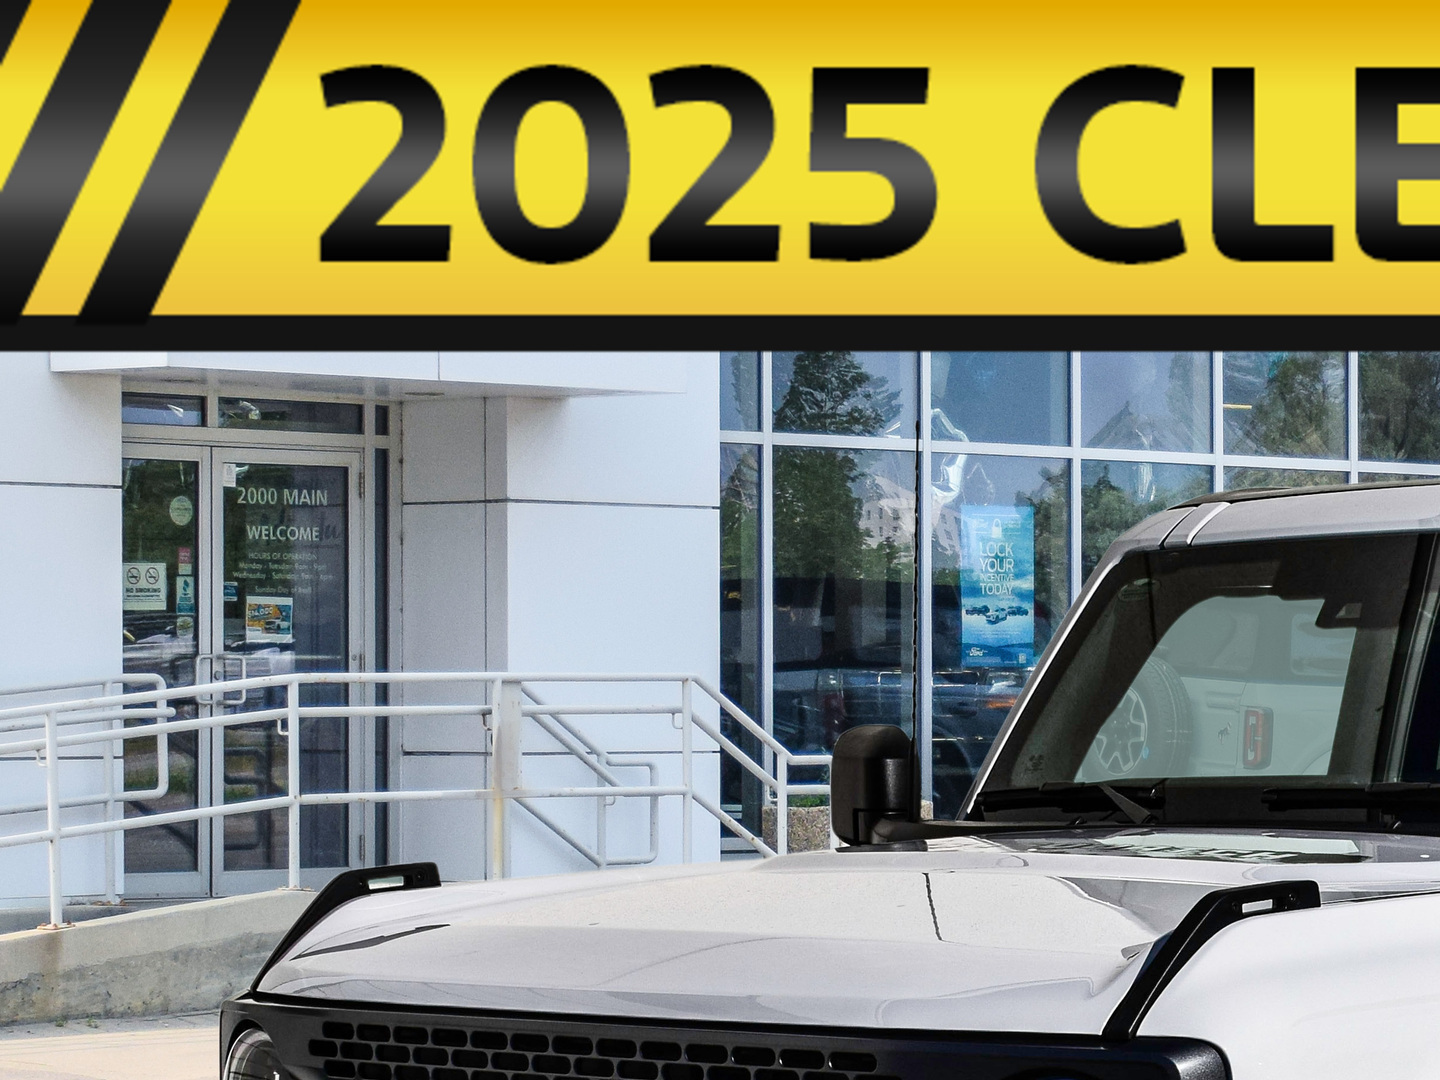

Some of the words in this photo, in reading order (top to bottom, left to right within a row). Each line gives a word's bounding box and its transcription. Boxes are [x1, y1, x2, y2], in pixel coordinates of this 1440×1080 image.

[237, 487, 278, 505] 2000
[283, 488, 328, 506] MAIN
[246, 524, 320, 541] WELCOME
[248, 552, 270, 560] HOURS
[979, 541, 1014, 557] LOCK
[979, 558, 1015, 572] YOUR
[980, 583, 1014, 595] TODAY
